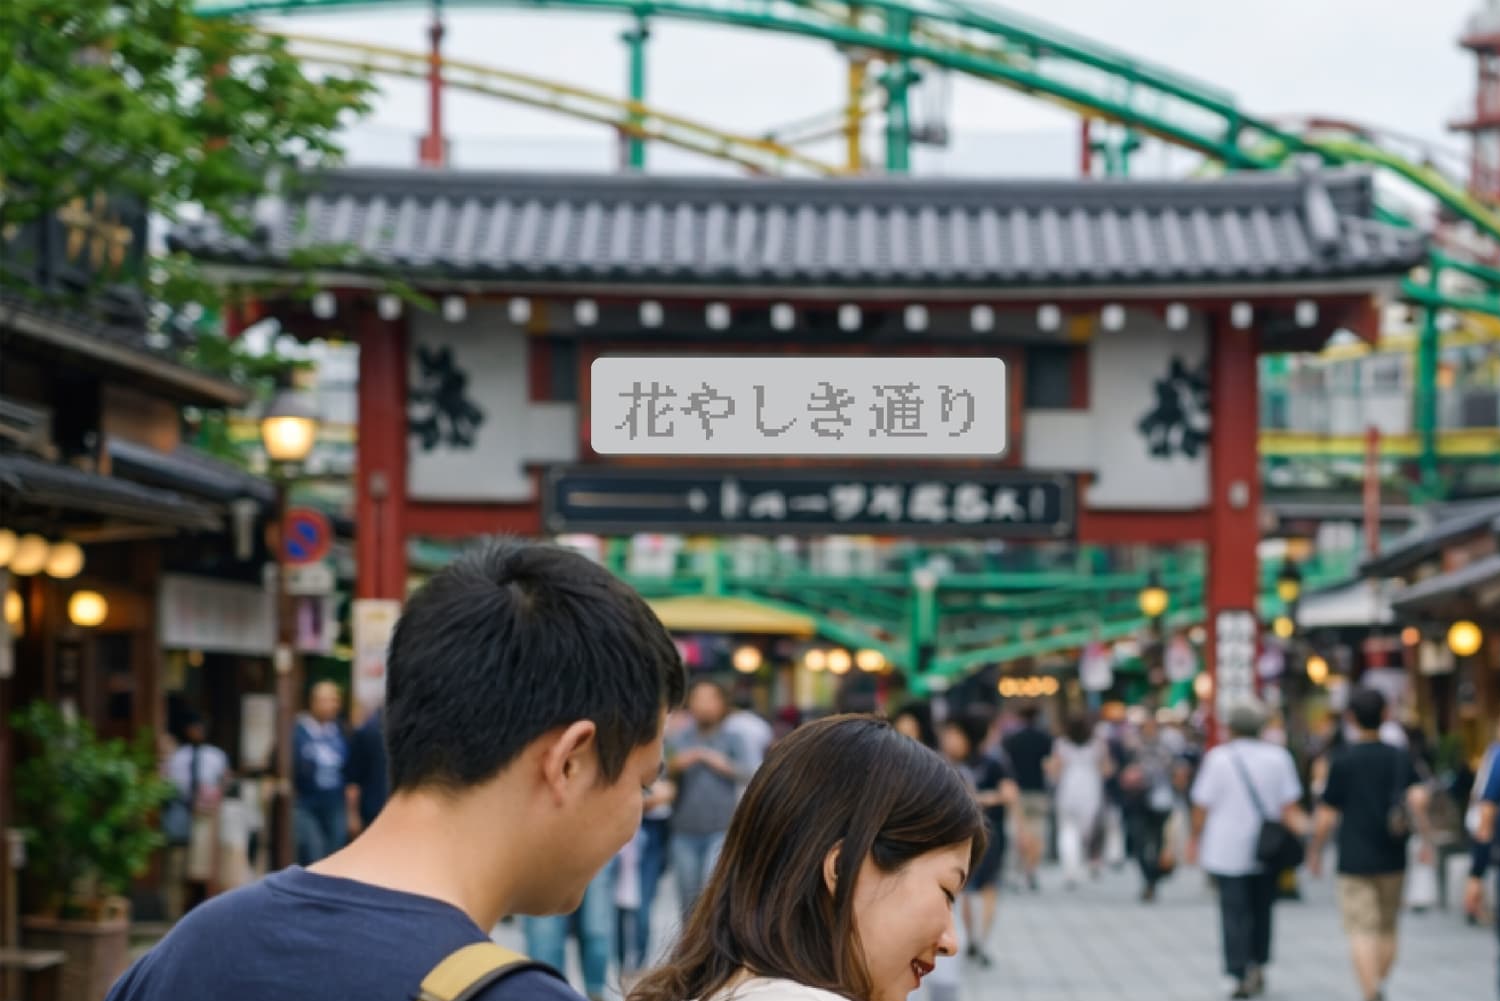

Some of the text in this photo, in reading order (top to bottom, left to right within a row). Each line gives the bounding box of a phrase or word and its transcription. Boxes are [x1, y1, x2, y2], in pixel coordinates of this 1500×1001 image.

[614, 381, 975, 441] 花やしき通り
